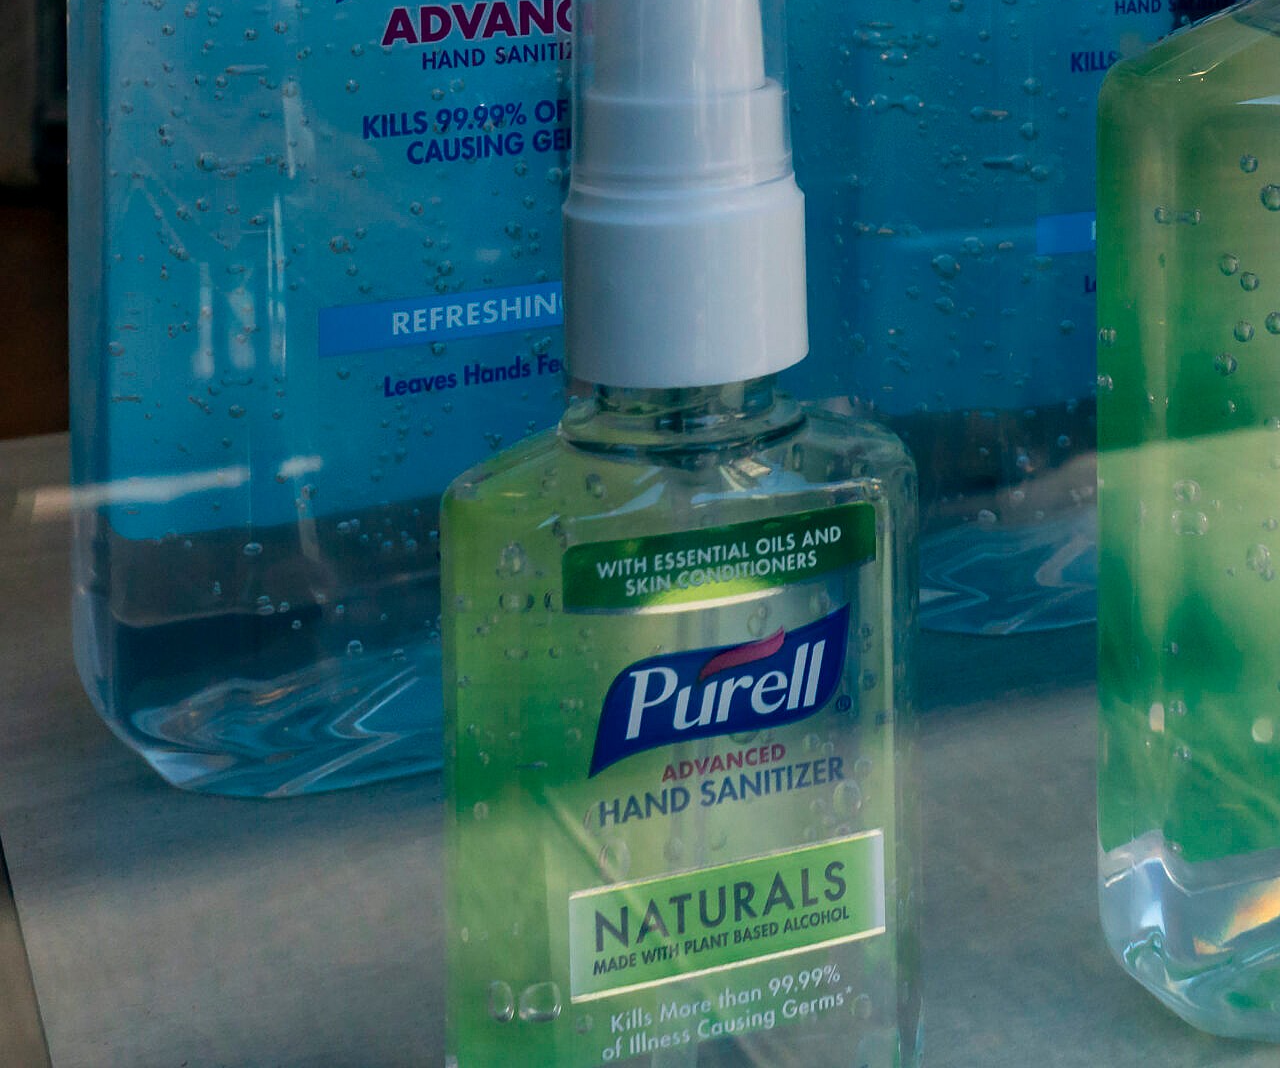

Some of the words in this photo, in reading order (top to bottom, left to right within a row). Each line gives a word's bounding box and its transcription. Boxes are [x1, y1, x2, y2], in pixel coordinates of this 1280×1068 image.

[421, 48, 486, 70] HAND
[1070, 50, 1117, 73] KILLS
[362, 110, 428, 140] KILLS
[435, 102, 527, 131] 99.99%
[534, 99, 570, 124] OF
[407, 131, 526, 165] CAUSING
[392, 291, 564, 336] REFRESHIN
[384, 372, 457, 398] Leaves
[463, 355, 532, 386] Hands
[596, 555, 648, 580] WITH
[653, 540, 750, 572] ESSENTIAL
[756, 534, 796, 555] OILS
[802, 525, 842, 546] AND
[625, 576, 672, 597] SKIN
[677, 549, 818, 588] CONDITIONERS
[625, 639, 826, 741] Purell
[661, 743, 786, 783] ADVANCED
[599, 786, 691, 828] HAND
[700, 756, 845, 808] SANITIZER
[594, 860, 847, 953] NATURALS
[593, 955, 637, 977] MADE
[641, 945, 680, 965] WITH
[684, 933, 729, 956] PLANT
[733, 923, 779, 944] BASED
[783, 905, 850, 934] ALCOHOL
[610, 1008, 651, 1033] Kills
[660, 997, 712, 1021] More
[718, 985, 762, 1008] than
[767, 964, 841, 996] 99.99%
[601, 1041, 622, 1061] of
[629, 1031, 690, 1055] Illness
[696, 1006, 776, 1039] Causing
